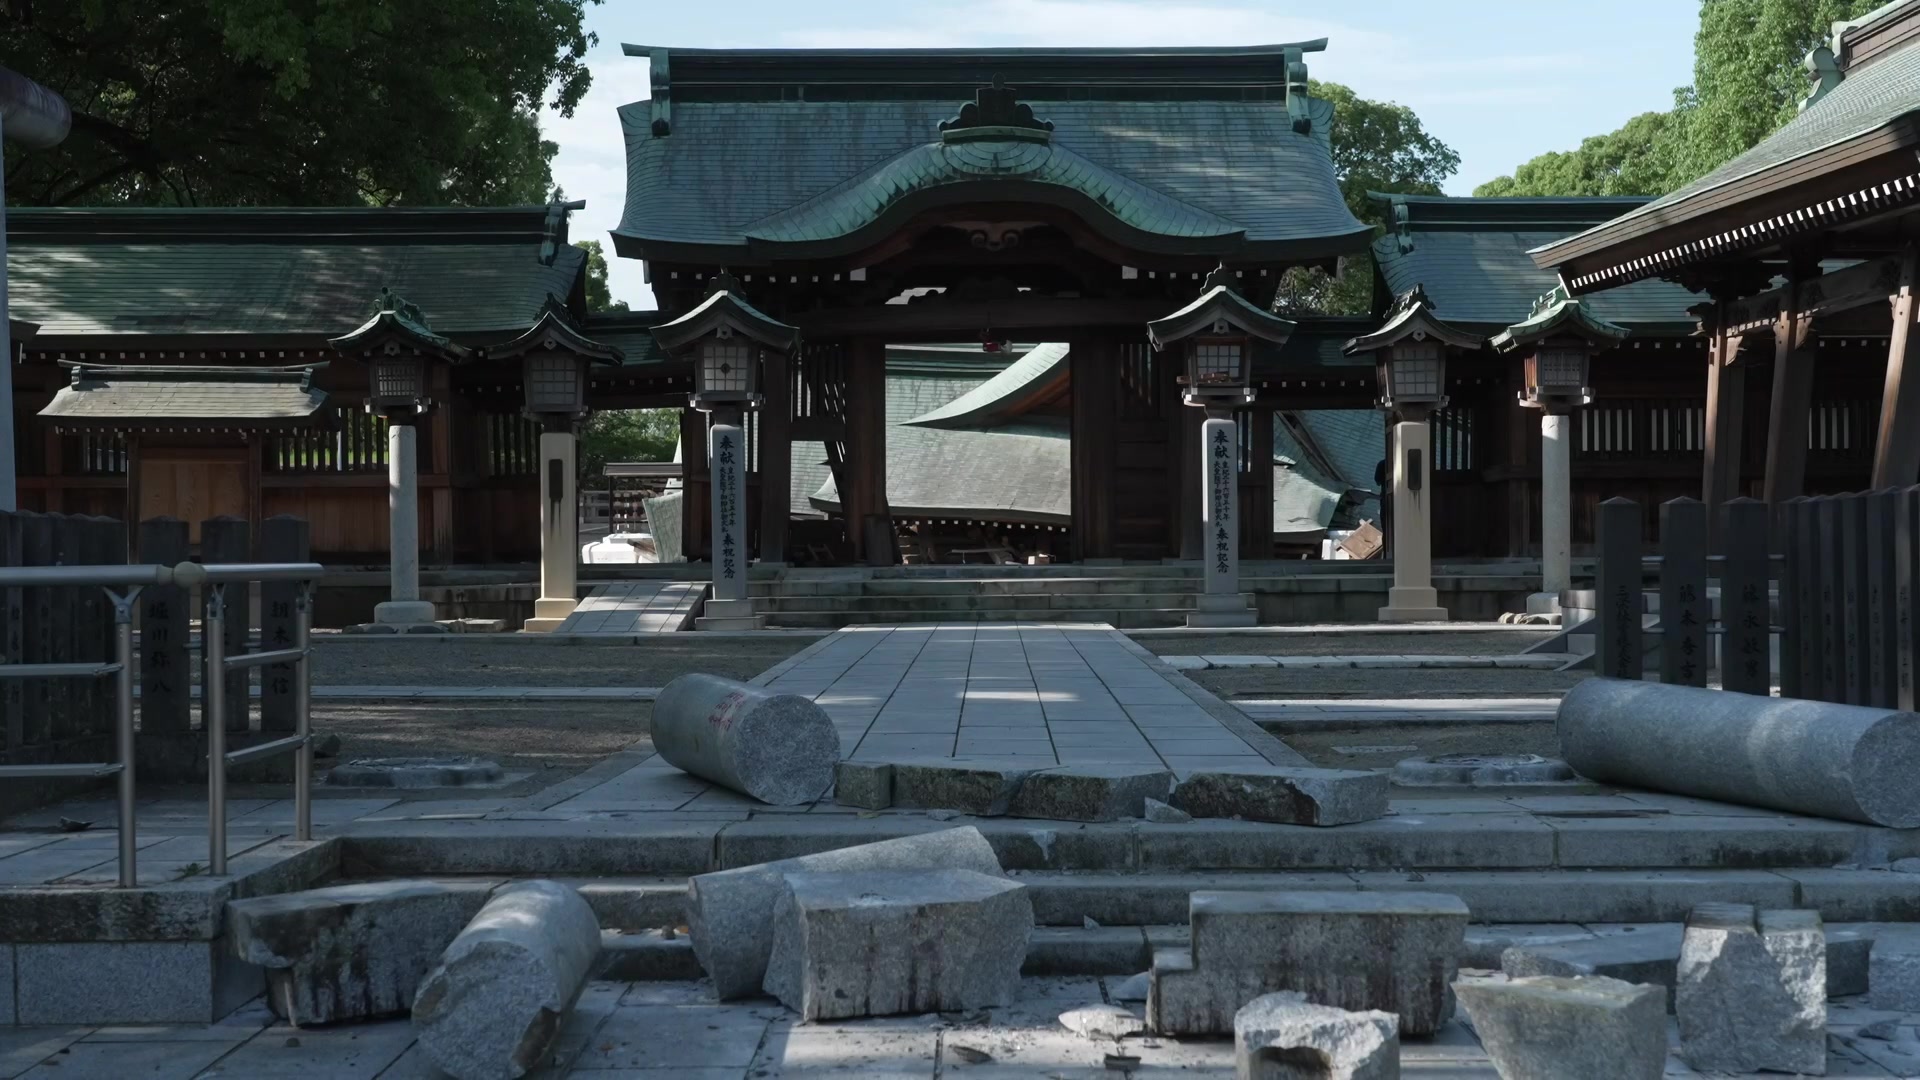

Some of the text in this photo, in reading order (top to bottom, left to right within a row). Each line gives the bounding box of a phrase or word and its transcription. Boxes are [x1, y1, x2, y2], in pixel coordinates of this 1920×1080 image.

[719, 435, 735, 465] 奉献
[1214, 429, 1230, 459] 奉献
[722, 533, 736, 579] 奉祝記念
[1216, 527, 1229, 574] 奉祝記念
